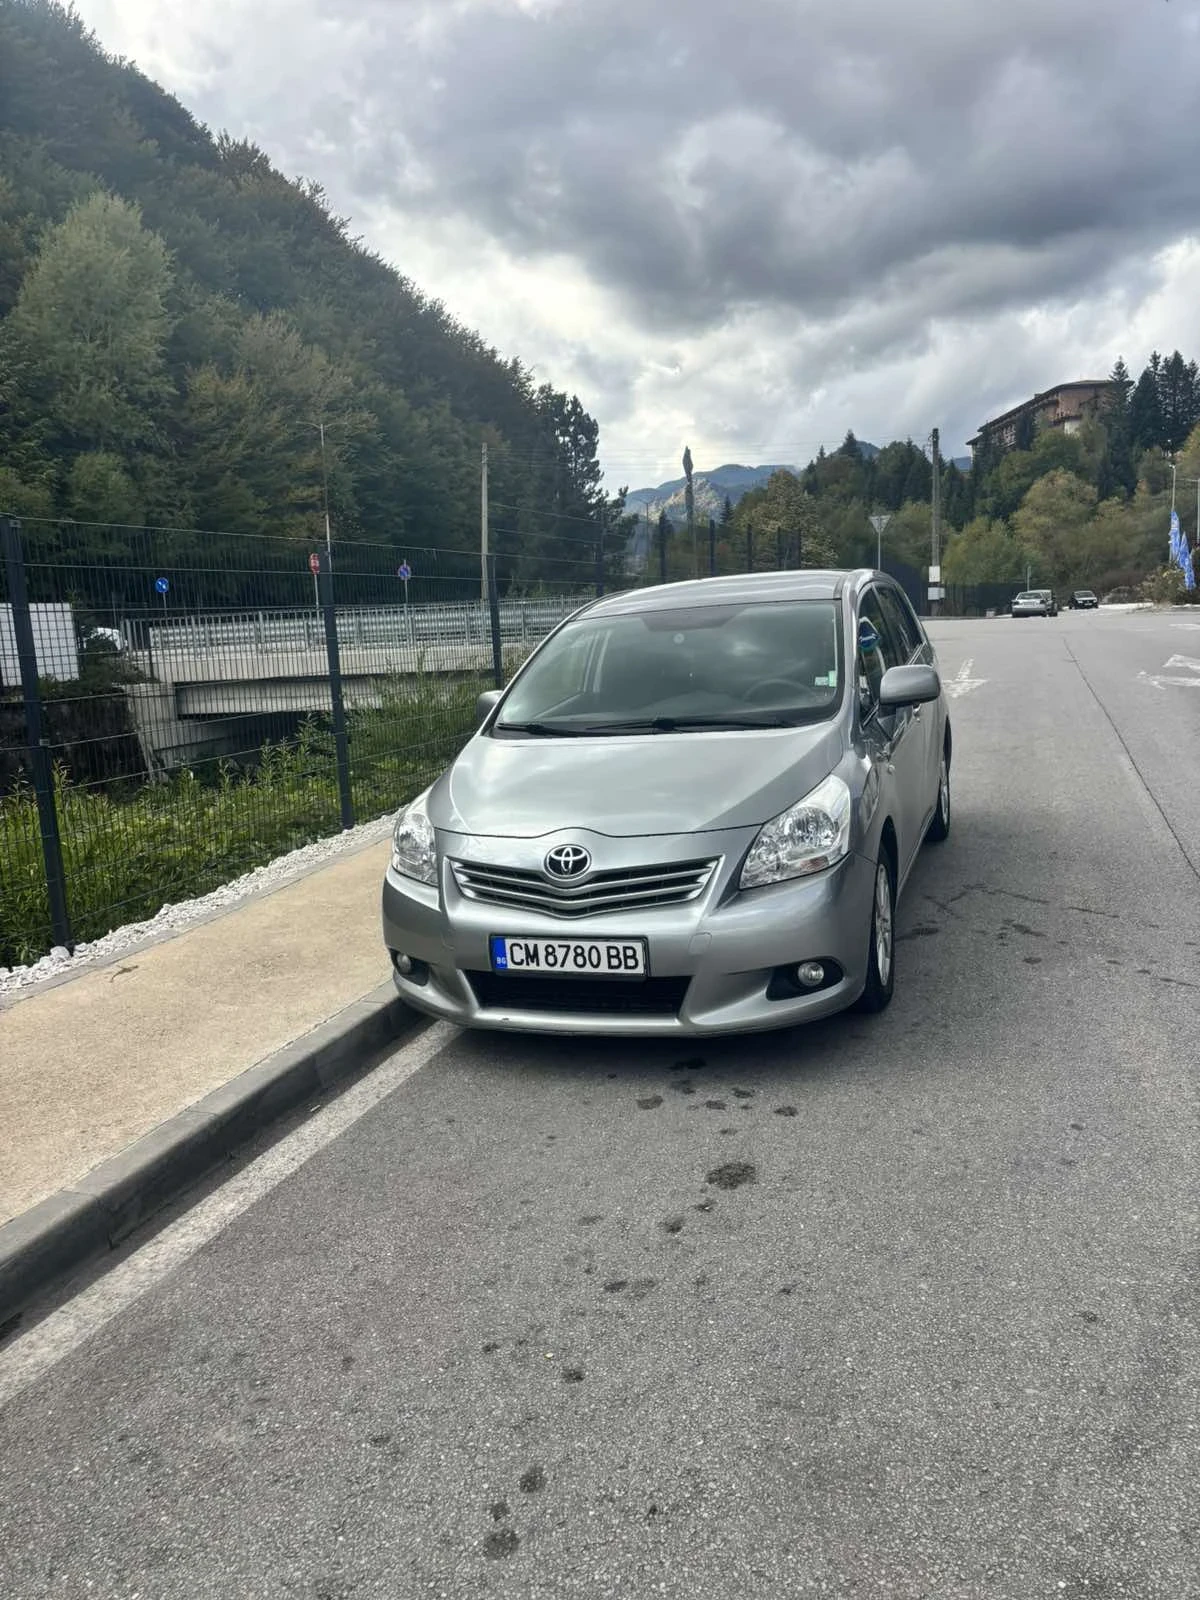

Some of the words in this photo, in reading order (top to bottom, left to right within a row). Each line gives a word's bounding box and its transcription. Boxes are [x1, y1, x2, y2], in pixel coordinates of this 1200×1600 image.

[496, 956, 507, 965] BG
[509, 943, 540, 967] CM
[544, 944, 601, 969] 8780
[606, 946, 639, 970] BB
